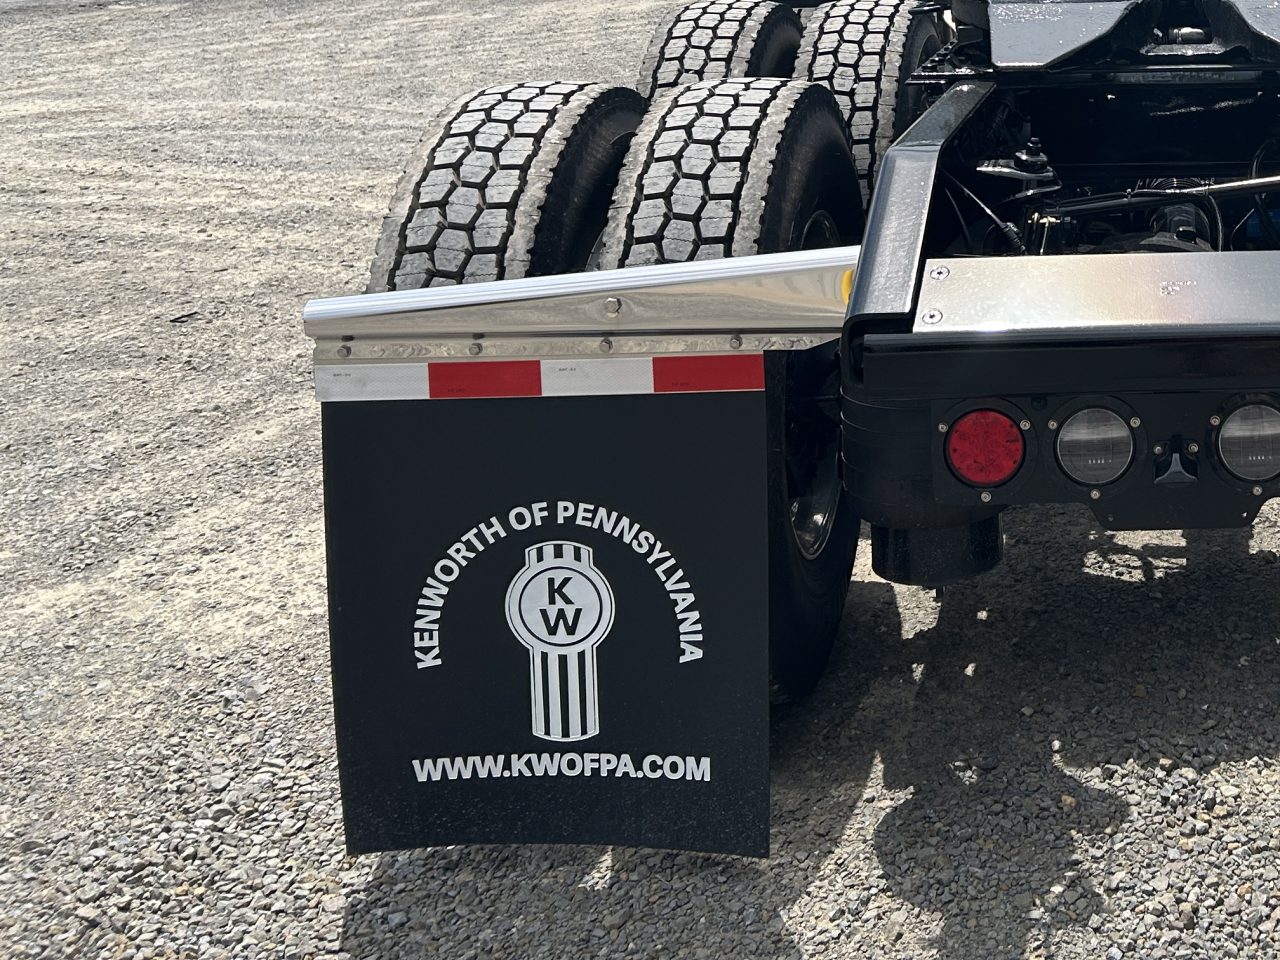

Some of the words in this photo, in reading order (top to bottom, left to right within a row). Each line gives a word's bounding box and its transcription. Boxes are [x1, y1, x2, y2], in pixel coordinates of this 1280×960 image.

[413, 516, 507, 670] KENWORTH
[508, 501, 549, 531] OF
[557, 500, 704, 664] PENNSYLVANIA
[411, 752, 711, 783] WWW.KWOFPA.COM
